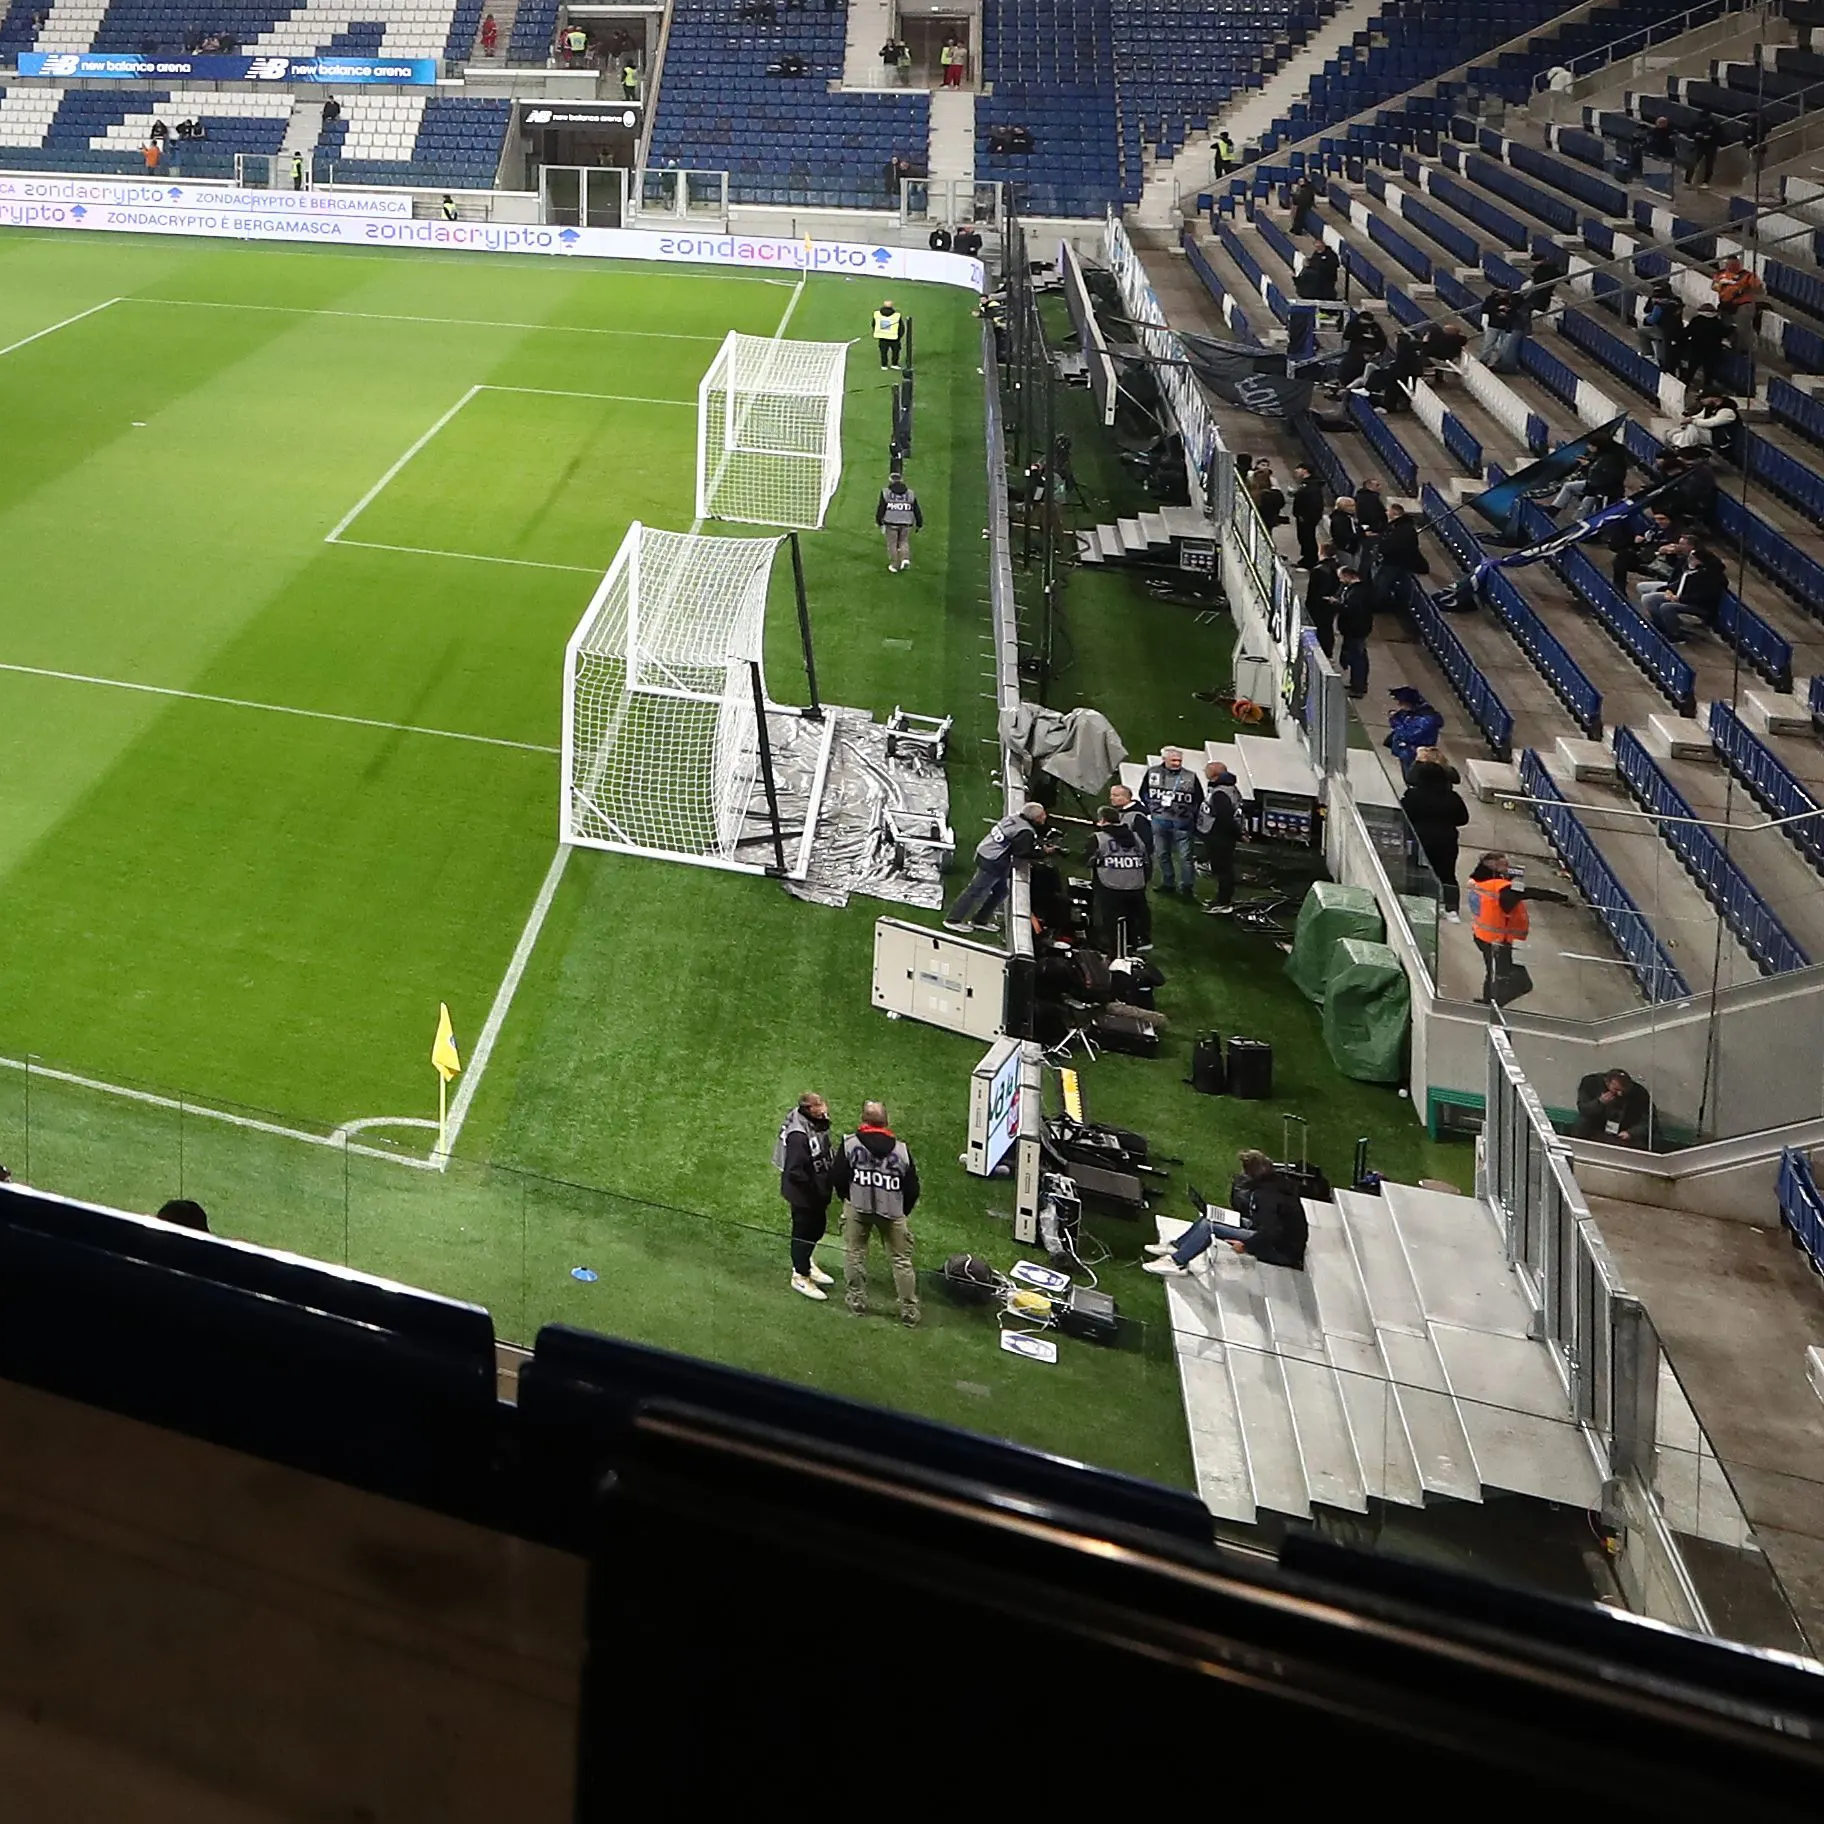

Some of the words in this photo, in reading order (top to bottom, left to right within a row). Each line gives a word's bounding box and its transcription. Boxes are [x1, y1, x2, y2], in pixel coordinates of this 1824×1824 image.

[81, 62, 104, 72] new
[106, 61, 154, 73] balance
[157, 63, 191, 73] arena
[291, 65, 316, 75] new
[318, 64, 371, 76] balance
[373, 67, 412, 77] arena
[24, 181, 164, 205] zondacrypto
[196, 193, 296, 208] ZONDACRYPTO
[310, 198, 406, 213] BERGAMASCA
[107, 212, 217, 228] ZONDACRYPTO
[234, 218, 342, 235] BERGAMASCA
[365, 221, 552, 250] zondacrypto
[659, 237, 867, 269] zondacrypto
[854, 1168, 900, 1190] PHOTO
